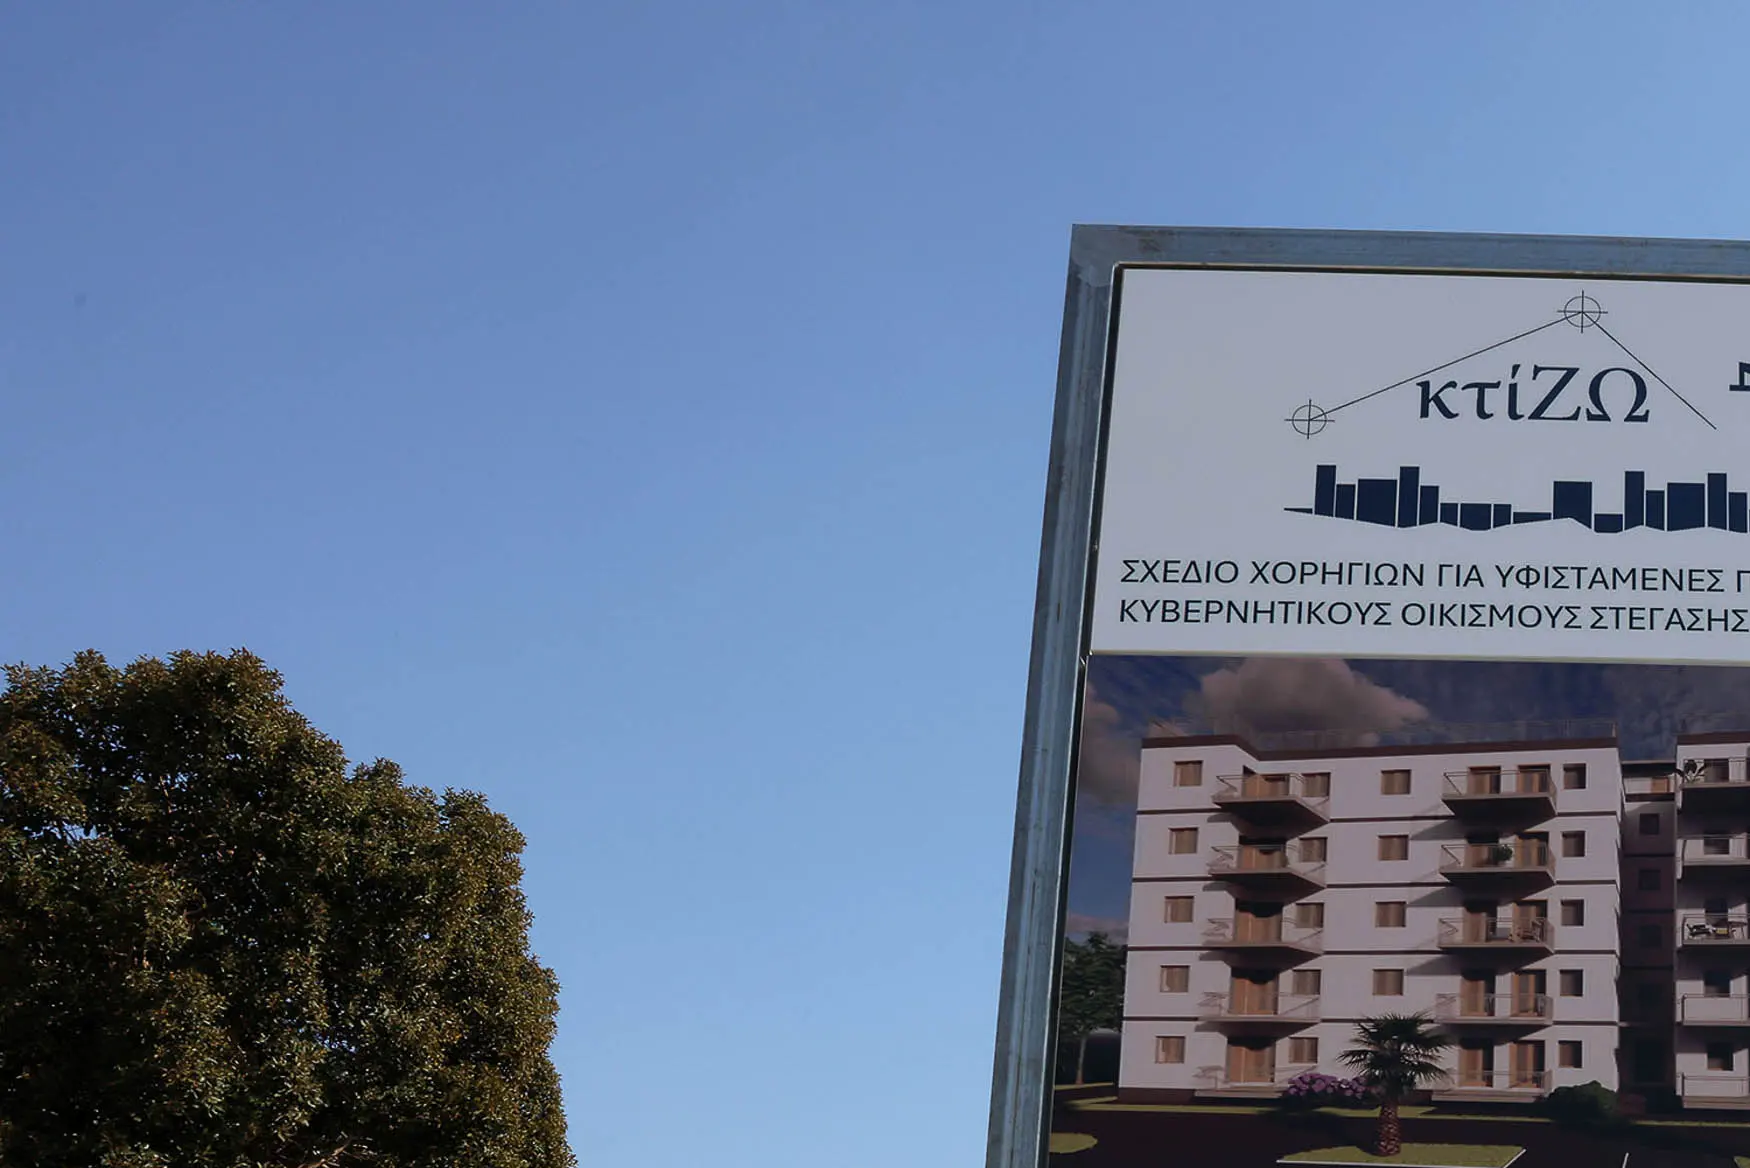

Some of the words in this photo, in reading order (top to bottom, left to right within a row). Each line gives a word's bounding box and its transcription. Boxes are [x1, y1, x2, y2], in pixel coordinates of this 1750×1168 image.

[1120, 559, 1240, 584] ΣΧΕΔΙΟ
[1248, 560, 1425, 587] ΧΟΡΗΓΙΩΝ
[1437, 563, 1485, 589] ΓΙΑ
[1494, 564, 1726, 593] ΥΦΙΣΤΑΜΕΝΕΣ
[1119, 599, 1393, 626] ΚΥΒΕΡΝΗΤΙΚΟΥΣ
[1400, 602, 1583, 630] ΟΙΚΙΣΜΟΥΣ
[1589, 606, 1750, 633] ΣΤΕΓΑΣΗΣ
